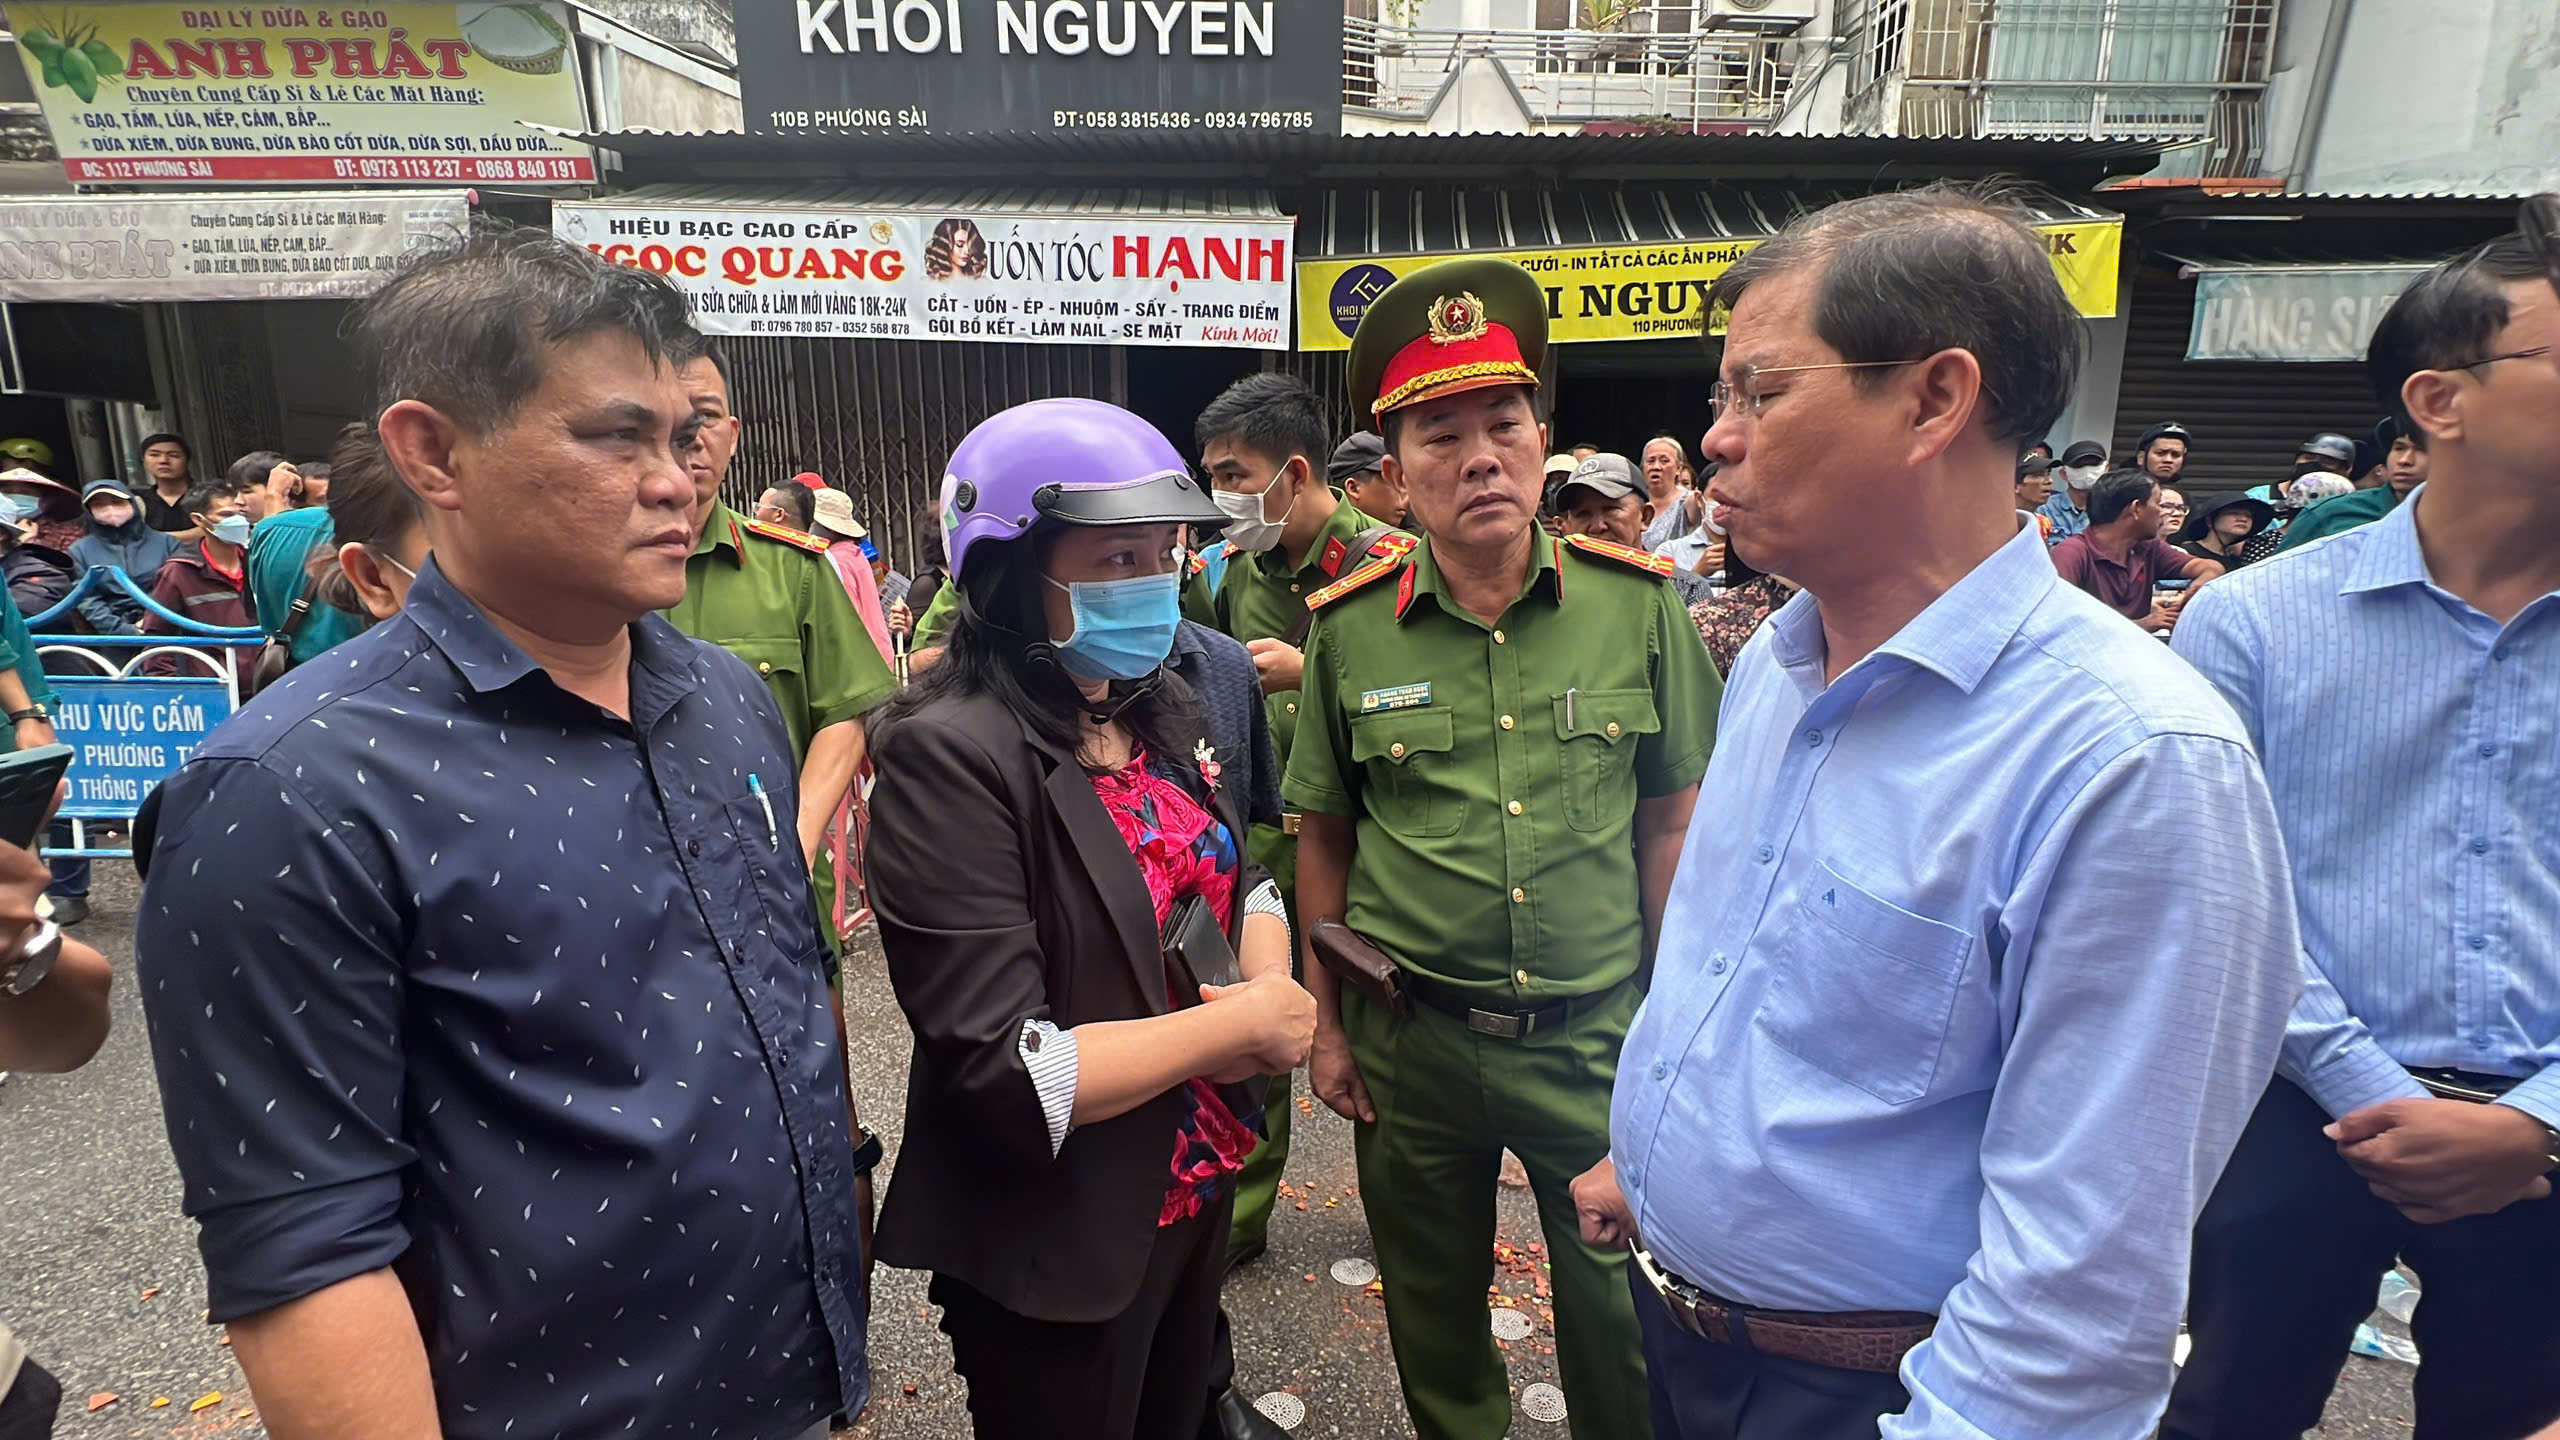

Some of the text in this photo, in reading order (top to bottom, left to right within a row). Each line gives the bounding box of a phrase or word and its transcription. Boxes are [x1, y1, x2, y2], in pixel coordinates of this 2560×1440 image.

[182, 6, 388, 32] ĐẠI LÝ DỪA & GẠO
[124, 27, 473, 80] ANH PHÁT
[126, 86, 193, 103] Chuyên
[197, 86, 243, 103] Cung
[247, 84, 280, 103] Cấp
[310, 86, 322, 101] &
[353, 85, 386, 101] Các
[389, 85, 425, 104] Mặt
[429, 86, 484, 104] Hàng:
[83, 112, 120, 131] GẠO,
[771, 111, 809, 127] 110B
[815, 109, 891, 127] PHƯƠNG
[898, 105, 928, 127] SÀI
[92, 135, 125, 151] DỪA
[127, 135, 173, 152] XIÊM,
[175, 135, 208, 150] DỪA
[211, 137, 260, 151] BUNG,
[262, 134, 296, 150] DỪA
[334, 131, 362, 150] CỐT
[367, 134, 405, 152] DỪA,
[408, 134, 440, 150] DỪA
[444, 135, 477, 153] SỢI,
[516, 134, 562, 151] DỪA...
[106, 162, 133, 176] 112
[132, 160, 189, 176] PHƯƠNG
[190, 158, 213, 176] SÀI
[334, 159, 358, 177] ĐT:
[360, 159, 398, 177] 0973
[401, 159, 430, 177] 113
[433, 160, 460, 177] 237
[476, 160, 514, 178] 0868
[517, 160, 546, 178] 840
[549, 160, 577, 178] 191
[191, 214, 226, 229] Chuyên
[228, 214, 253, 228] Cung
[256, 211, 275, 227] Cấp
[291, 213, 298, 226] &
[316, 212, 335, 226] Các
[610, 217, 857, 239] HIỆU BẠC CAO CẤP
[0, 229, 174, 280] NH PHÁT
[262, 258, 290, 273] BUNG,
[988, 224, 1285, 293] UỐN TÓC HẠNH
[1572, 257, 1586, 270] IN
[1590, 251, 1619, 269] TẤT
[1647, 252, 1678, 266] CÁC
[721, 246, 905, 286] QUANG
[702, 286, 725, 313] SỬA
[728, 290, 758, 314] CHỮA
[762, 294, 770, 314] &
[774, 290, 798, 314] LÀM
[802, 291, 822, 315] MỚI
[826, 291, 856, 315] VÀNG
[860, 297, 907, 317] 18K-24K
[928, 293, 958, 312] CẮT
[974, 294, 1006, 313] UỐN
[1023, 297, 1043, 314] ÉP
[1060, 299, 1118, 319] NHUỘM
[1135, 298, 1166, 317] SẤY
[1183, 304, 1233, 318] TRANG
[1239, 300, 1279, 321] ĐIỂM
[1336, 305, 1358, 316] KHOI
[751, 320, 764, 332] ĐT:
[768, 321, 792, 332] 0796
[795, 321, 812, 332] 780
[815, 321, 832, 332] 857
[842, 322, 867, 333] 0352
[870, 323, 888, 334] 568
[892, 323, 909, 334] 878
[929, 316, 954, 336] GỘI
[987, 317, 1015, 335] KẾT
[1031, 319, 1064, 336] LÀM
[1071, 323, 1106, 337] NAIL
[1123, 324, 1143, 338] SE
[1149, 322, 1182, 342] MẶT
[1201, 326, 1278, 343] Kính Mời!
[1633, 321, 1650, 332] 110
[1652, 318, 1700, 332] PHƯƠNG
[98, 701, 144, 736] VỰC
[152, 695, 204, 732] CẤM
[85, 742, 165, 767] PHƯƠNG
[79, 774, 137, 800] THÔNG
